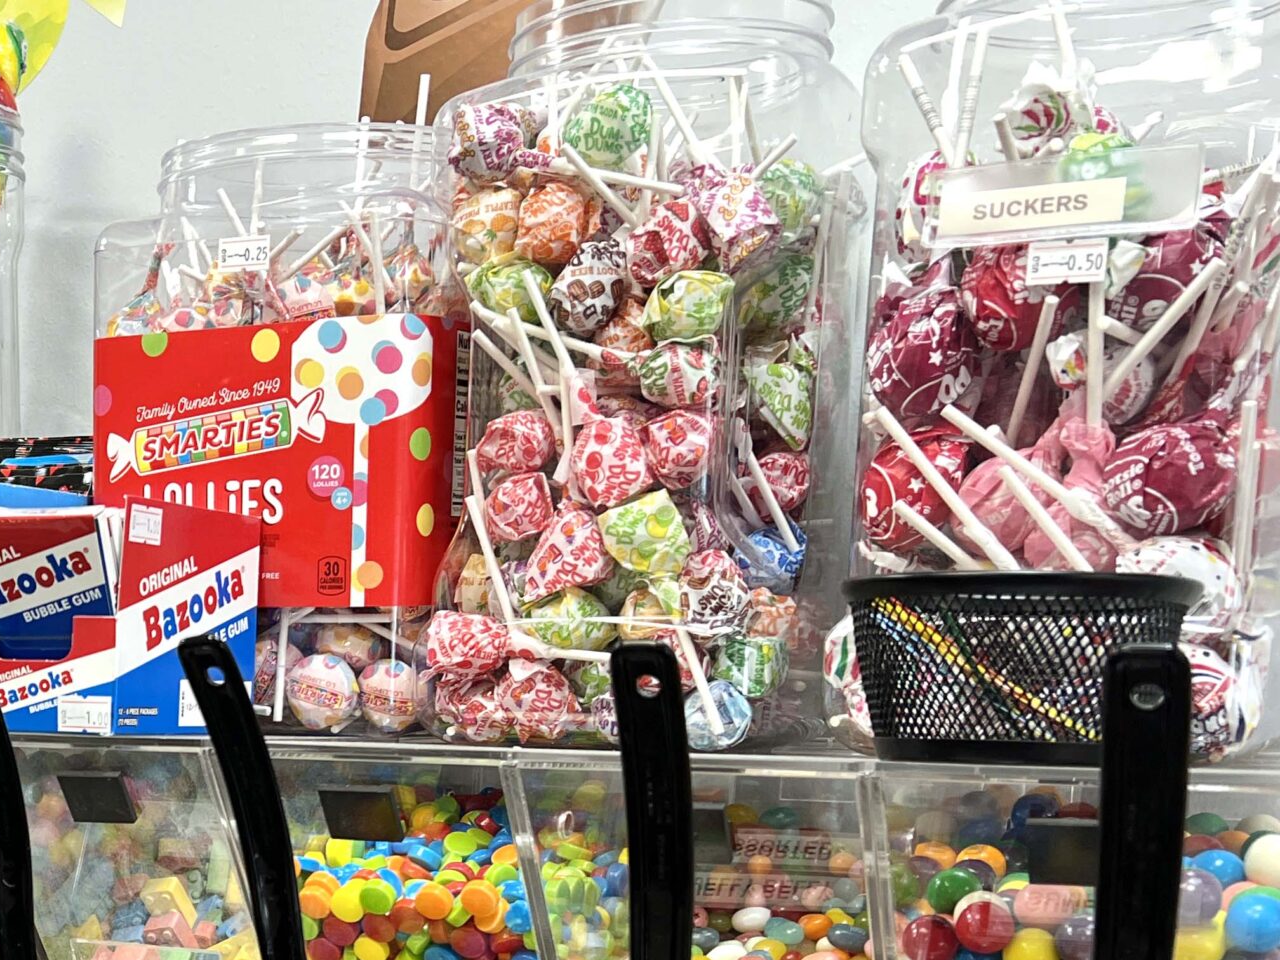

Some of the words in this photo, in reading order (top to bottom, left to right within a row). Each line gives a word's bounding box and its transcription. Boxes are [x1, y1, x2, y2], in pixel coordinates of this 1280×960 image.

[972, 193, 1089, 222] SUCKERS
[136, 402, 176, 423] Family
[177, 392, 218, 413] Owned
[218, 387, 251, 406] Since
[252, 377, 281, 397] 1949
[142, 412, 281, 463] SMARTIES
[311, 464, 340, 479] 120
[138, 556, 198, 596] ORIGINAL
[261, 572, 280, 580] FREE
[324, 562, 340, 577] 30
[22, 601, 71, 624] BUBBLE
[72, 587, 103, 608] GUM
[142, 563, 245, 652] Bazooka
[226, 616, 250, 642] GUM
